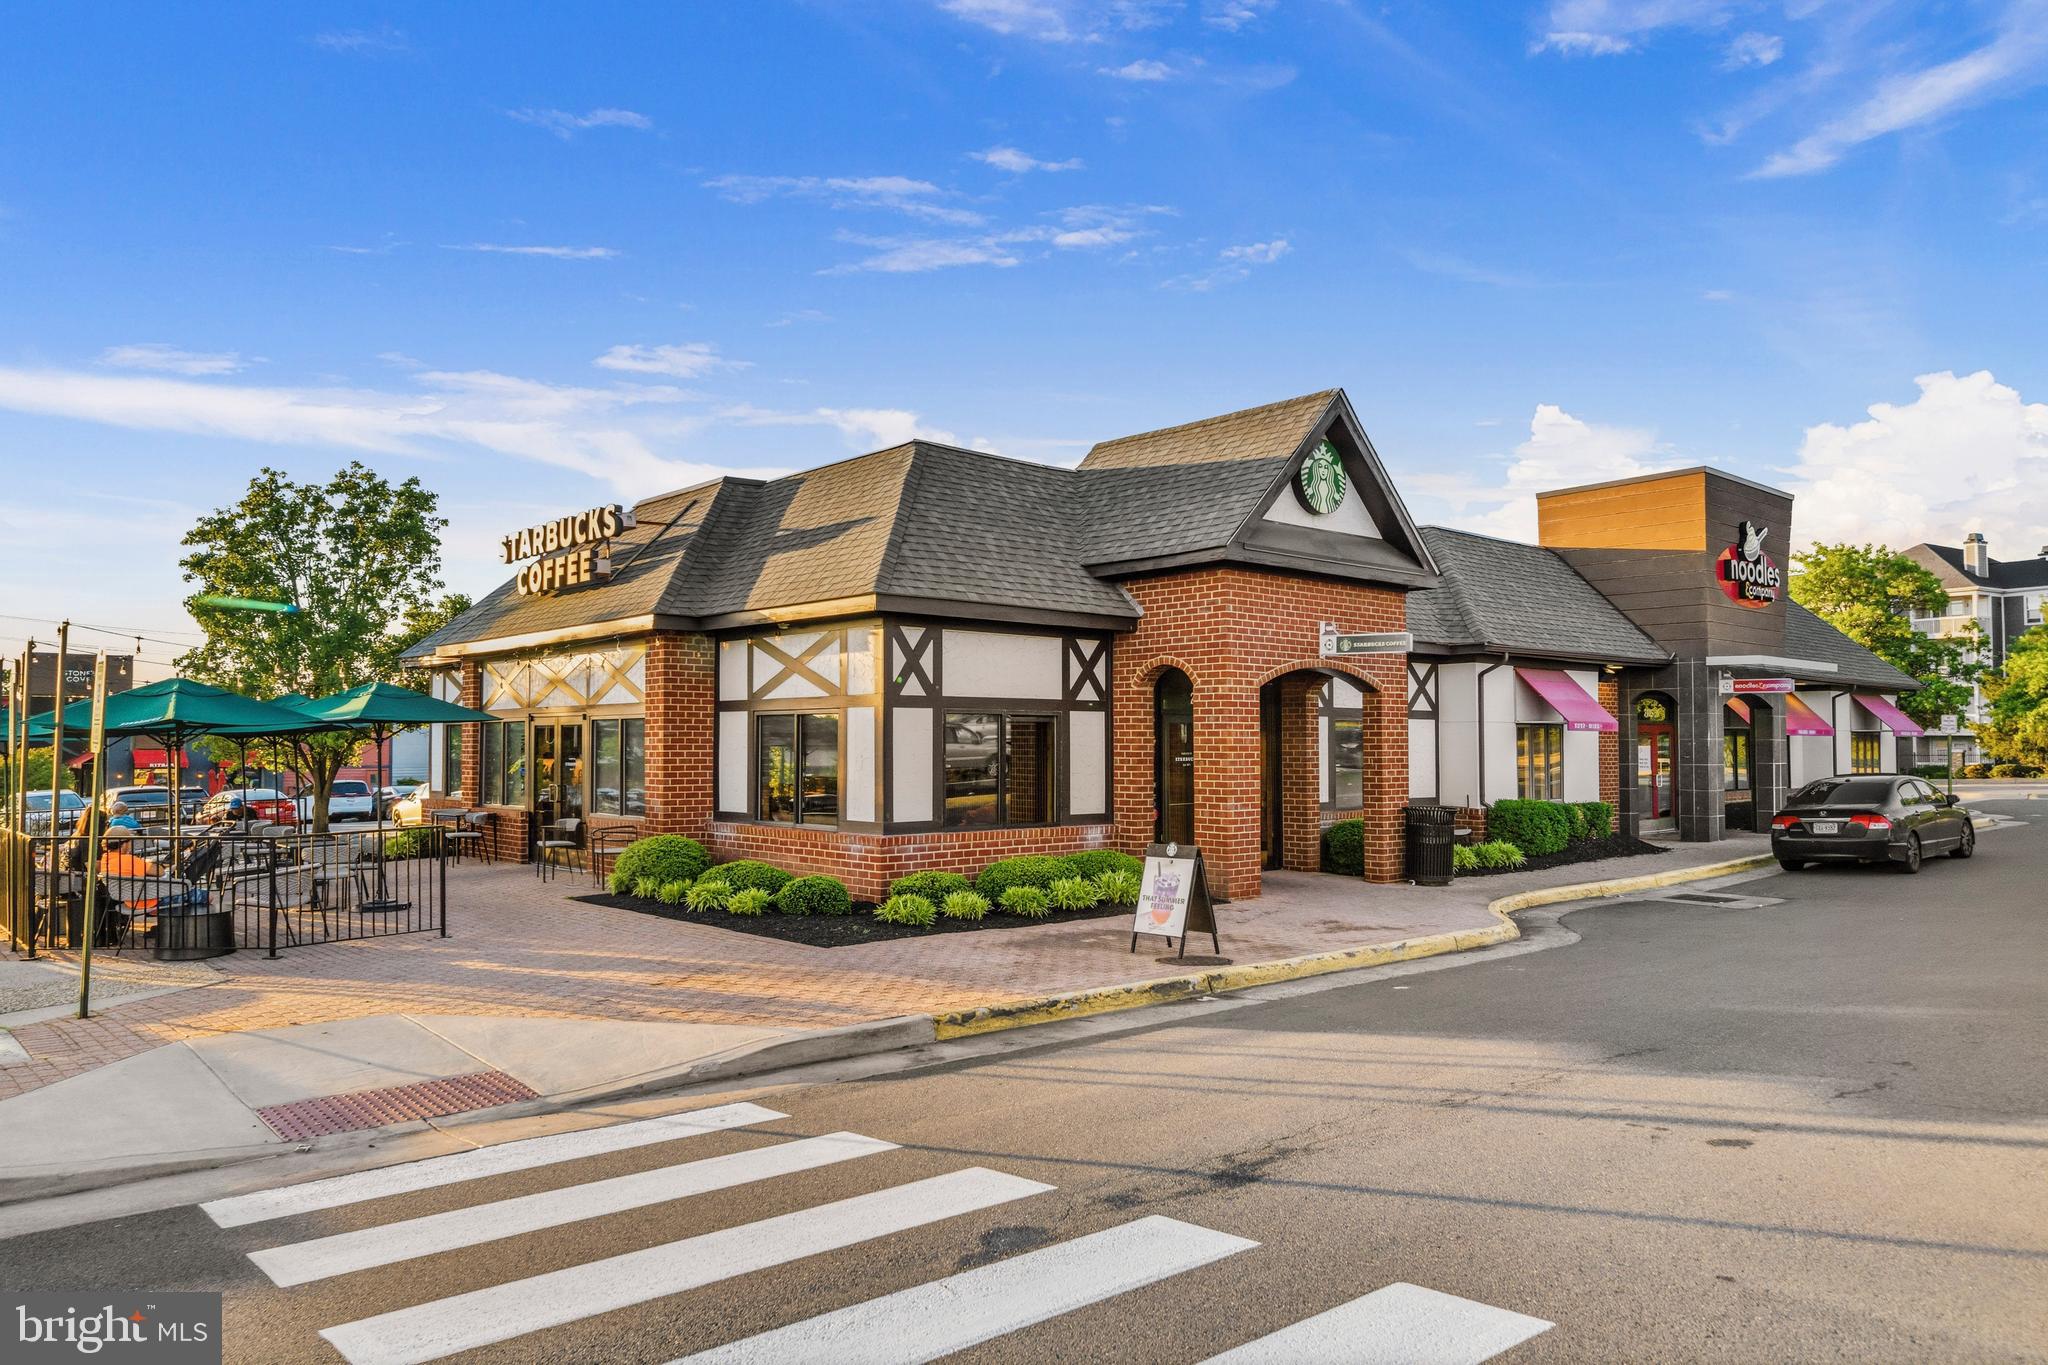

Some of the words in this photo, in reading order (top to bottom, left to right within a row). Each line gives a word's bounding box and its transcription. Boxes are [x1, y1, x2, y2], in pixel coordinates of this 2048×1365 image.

[499, 504, 617, 564] STARBUCKS
[516, 549, 592, 596] COFFEE
[1731, 555, 1781, 587] noodles
[1142, 894, 1158, 902] THAT
[1158, 895, 1185, 905] SUMMER
[1150, 902, 1175, 912] FEELING
